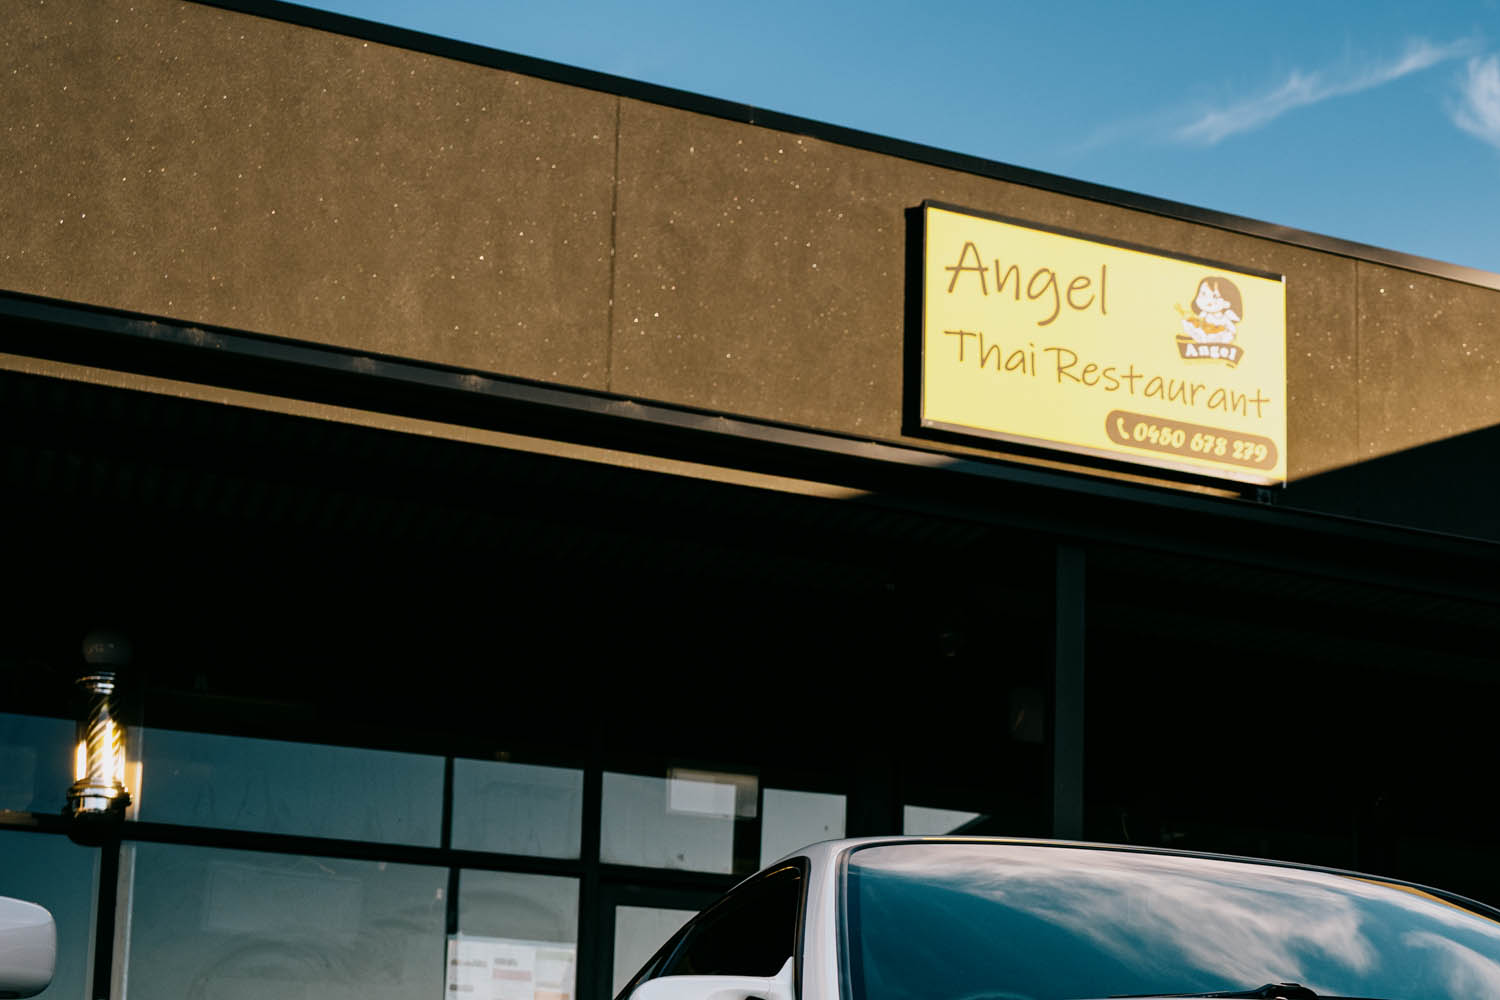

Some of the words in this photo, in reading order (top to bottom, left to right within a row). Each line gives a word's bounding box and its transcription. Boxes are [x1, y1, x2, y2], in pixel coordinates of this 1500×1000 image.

[945, 241, 1108, 326] Angel
[944, 329, 1037, 378] Thai
[1043, 346, 1271, 418] Restaurant
[1185, 343, 1237, 361] Angel
[1190, 432, 1228, 457] 678
[1232, 439, 1268, 463] 279
